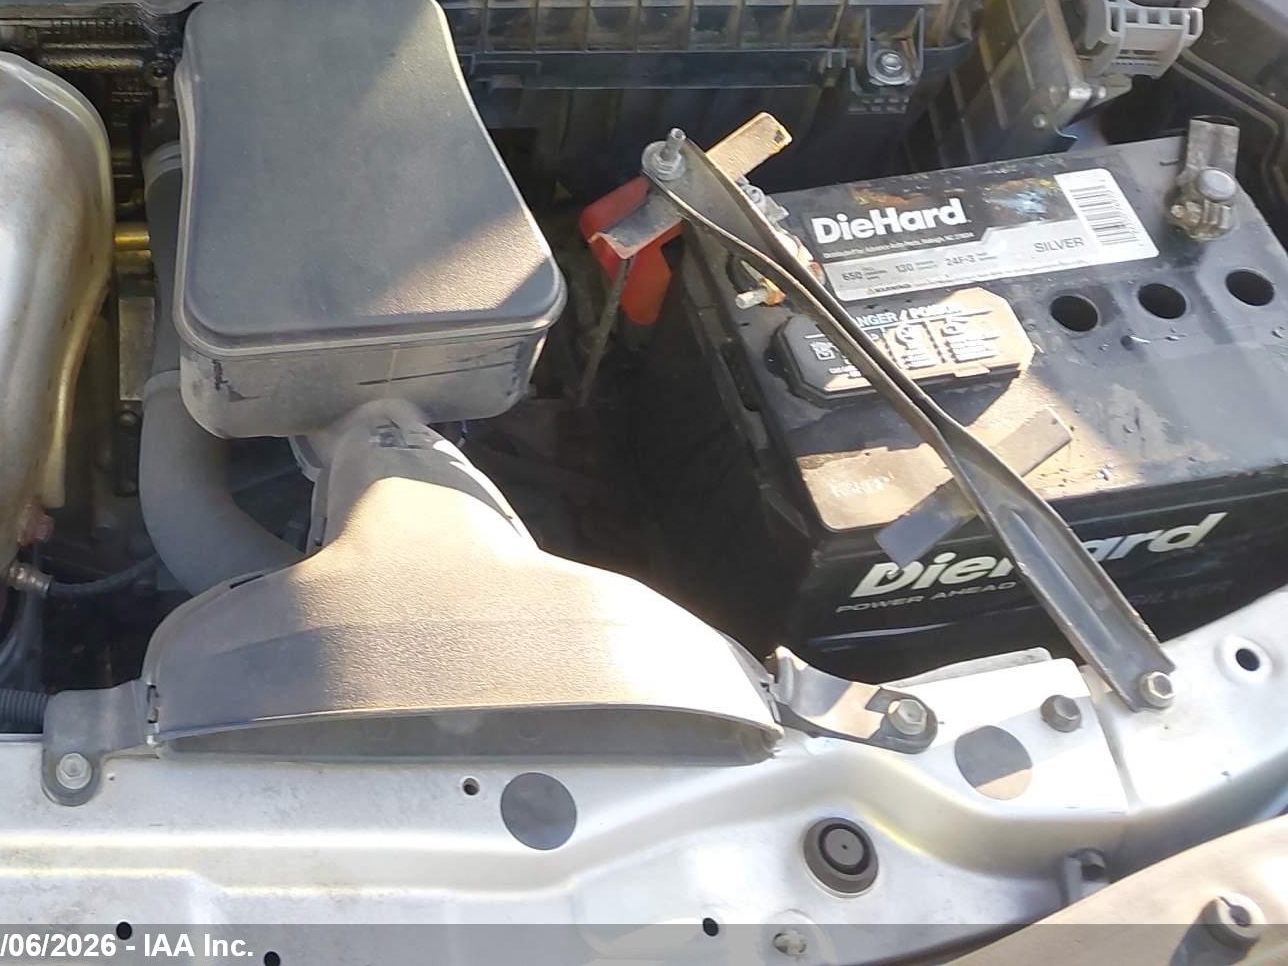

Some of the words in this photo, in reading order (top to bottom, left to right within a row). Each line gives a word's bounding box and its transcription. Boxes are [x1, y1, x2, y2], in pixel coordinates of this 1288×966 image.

[811, 197, 969, 245] DieHard
[1033, 236, 1086, 254] SILVER
[835, 594, 925, 613] POWER
[929, 581, 1017, 600] AHEAD
